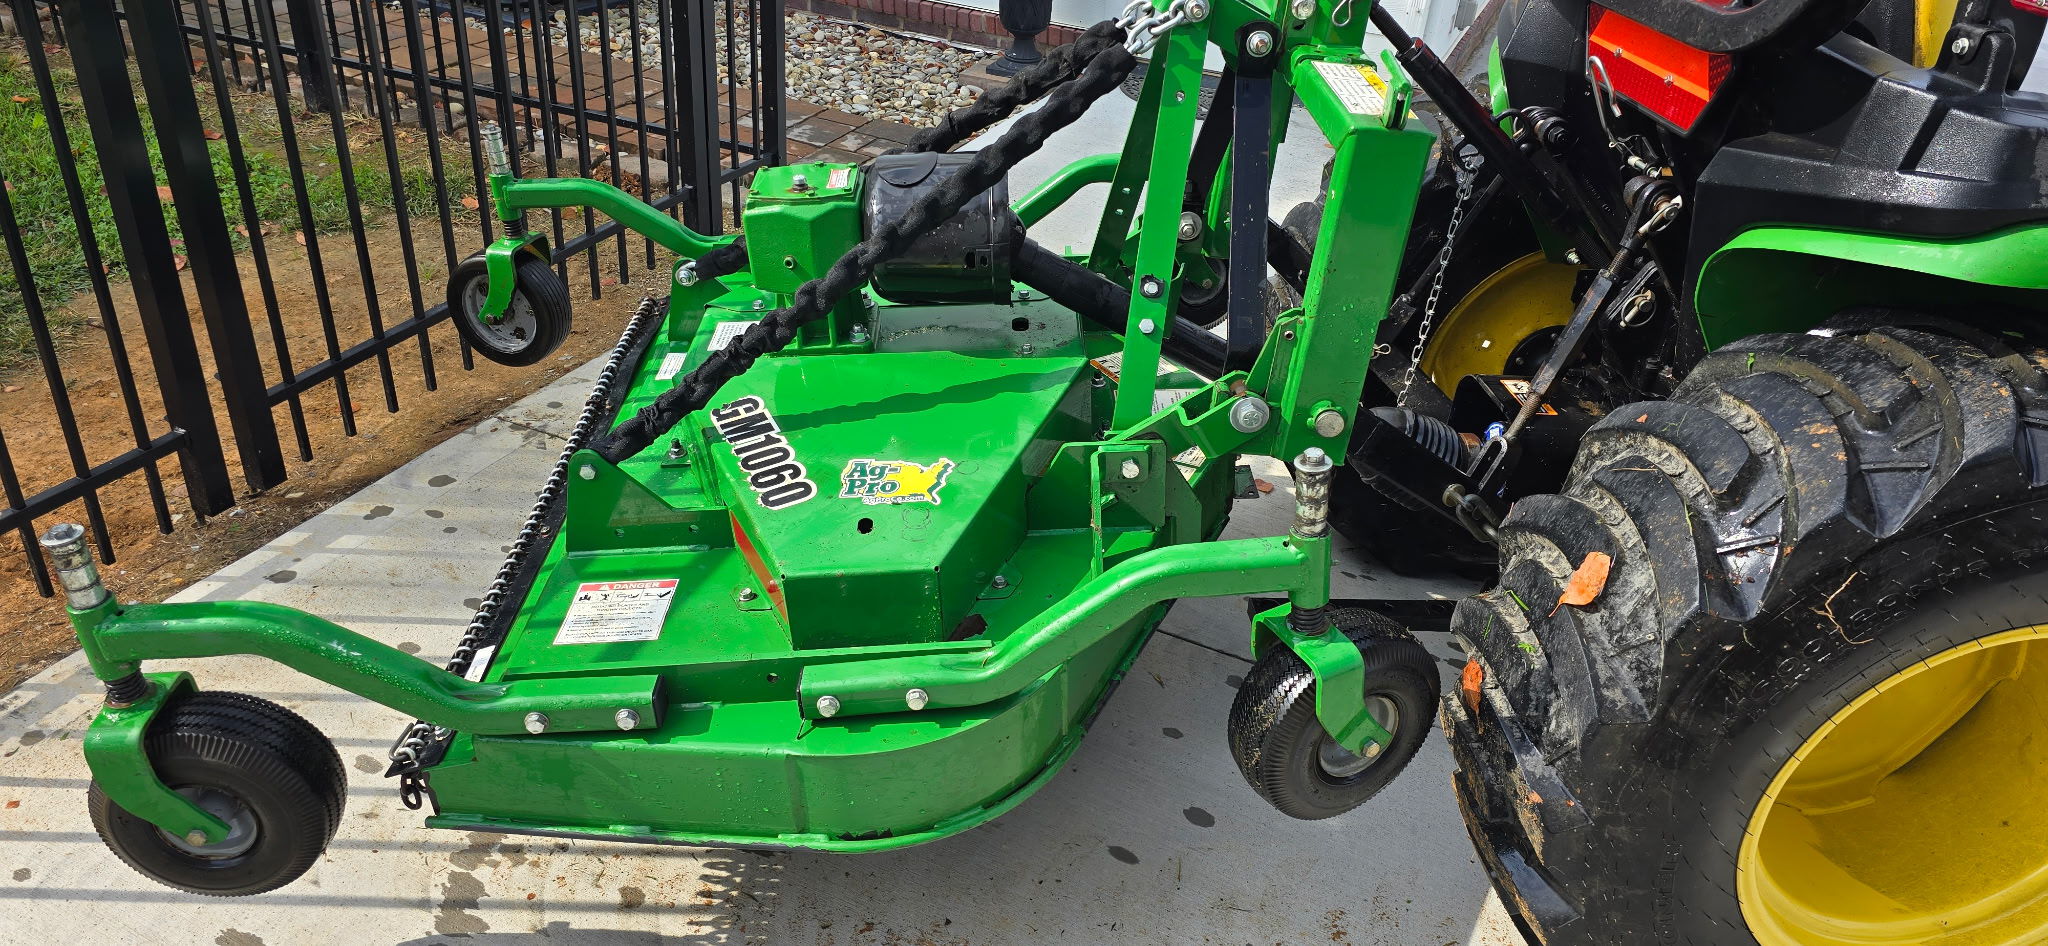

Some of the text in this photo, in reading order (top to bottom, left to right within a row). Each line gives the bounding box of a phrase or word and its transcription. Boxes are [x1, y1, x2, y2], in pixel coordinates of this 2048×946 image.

[711, 397, 814, 508] GM1060
[845, 462, 900, 481] Ag-
[843, 479, 899, 495] Pro
[613, 582, 660, 590] DANGER
